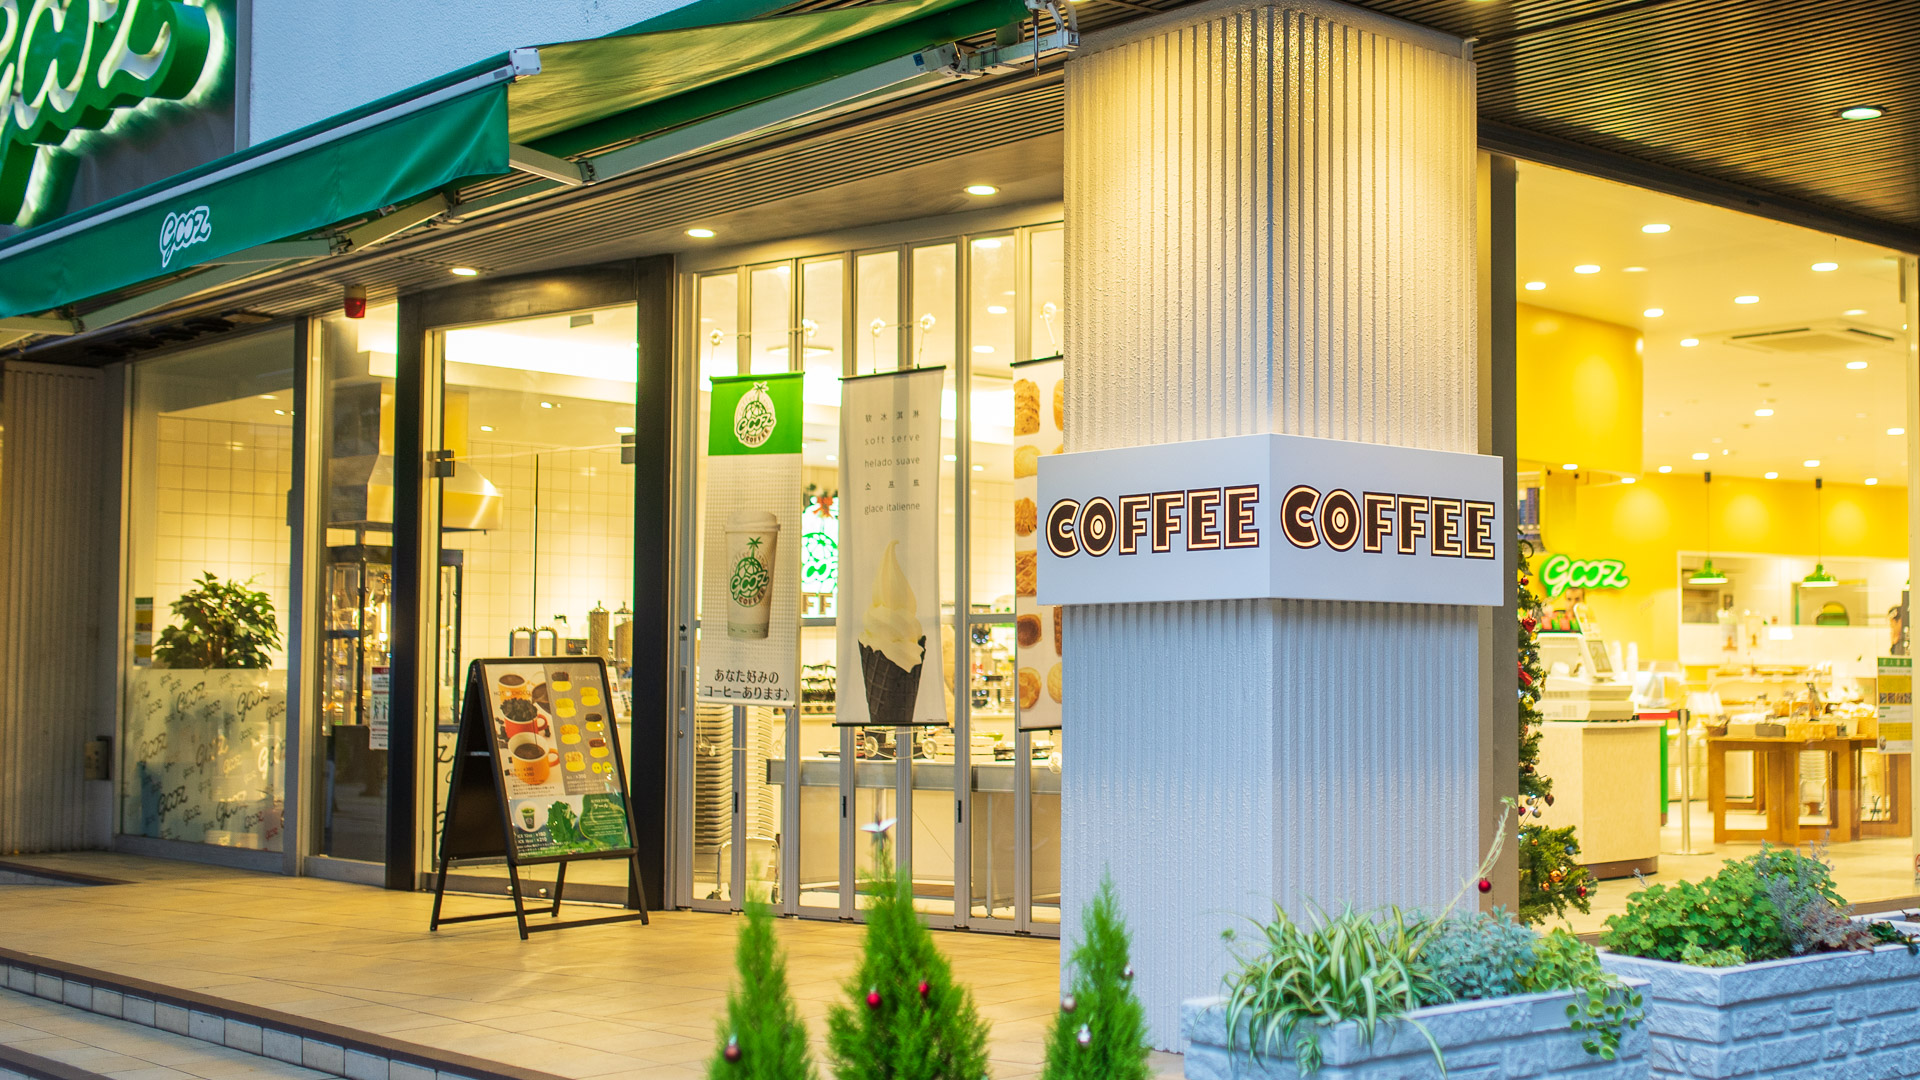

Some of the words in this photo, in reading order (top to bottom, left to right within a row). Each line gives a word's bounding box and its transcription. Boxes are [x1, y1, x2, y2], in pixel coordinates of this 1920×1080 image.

[865, 436, 885, 446] soft
[891, 434, 920, 444] serve
[864, 458, 893, 468] helado
[896, 456, 920, 466] suave
[864, 504, 884, 515] glace
[886, 502, 920, 512] italienne
[1046, 484, 1260, 558] COFFEE
[1280, 484, 1496, 560] COFFEE
[714, 668, 779, 684] あなた好みの
